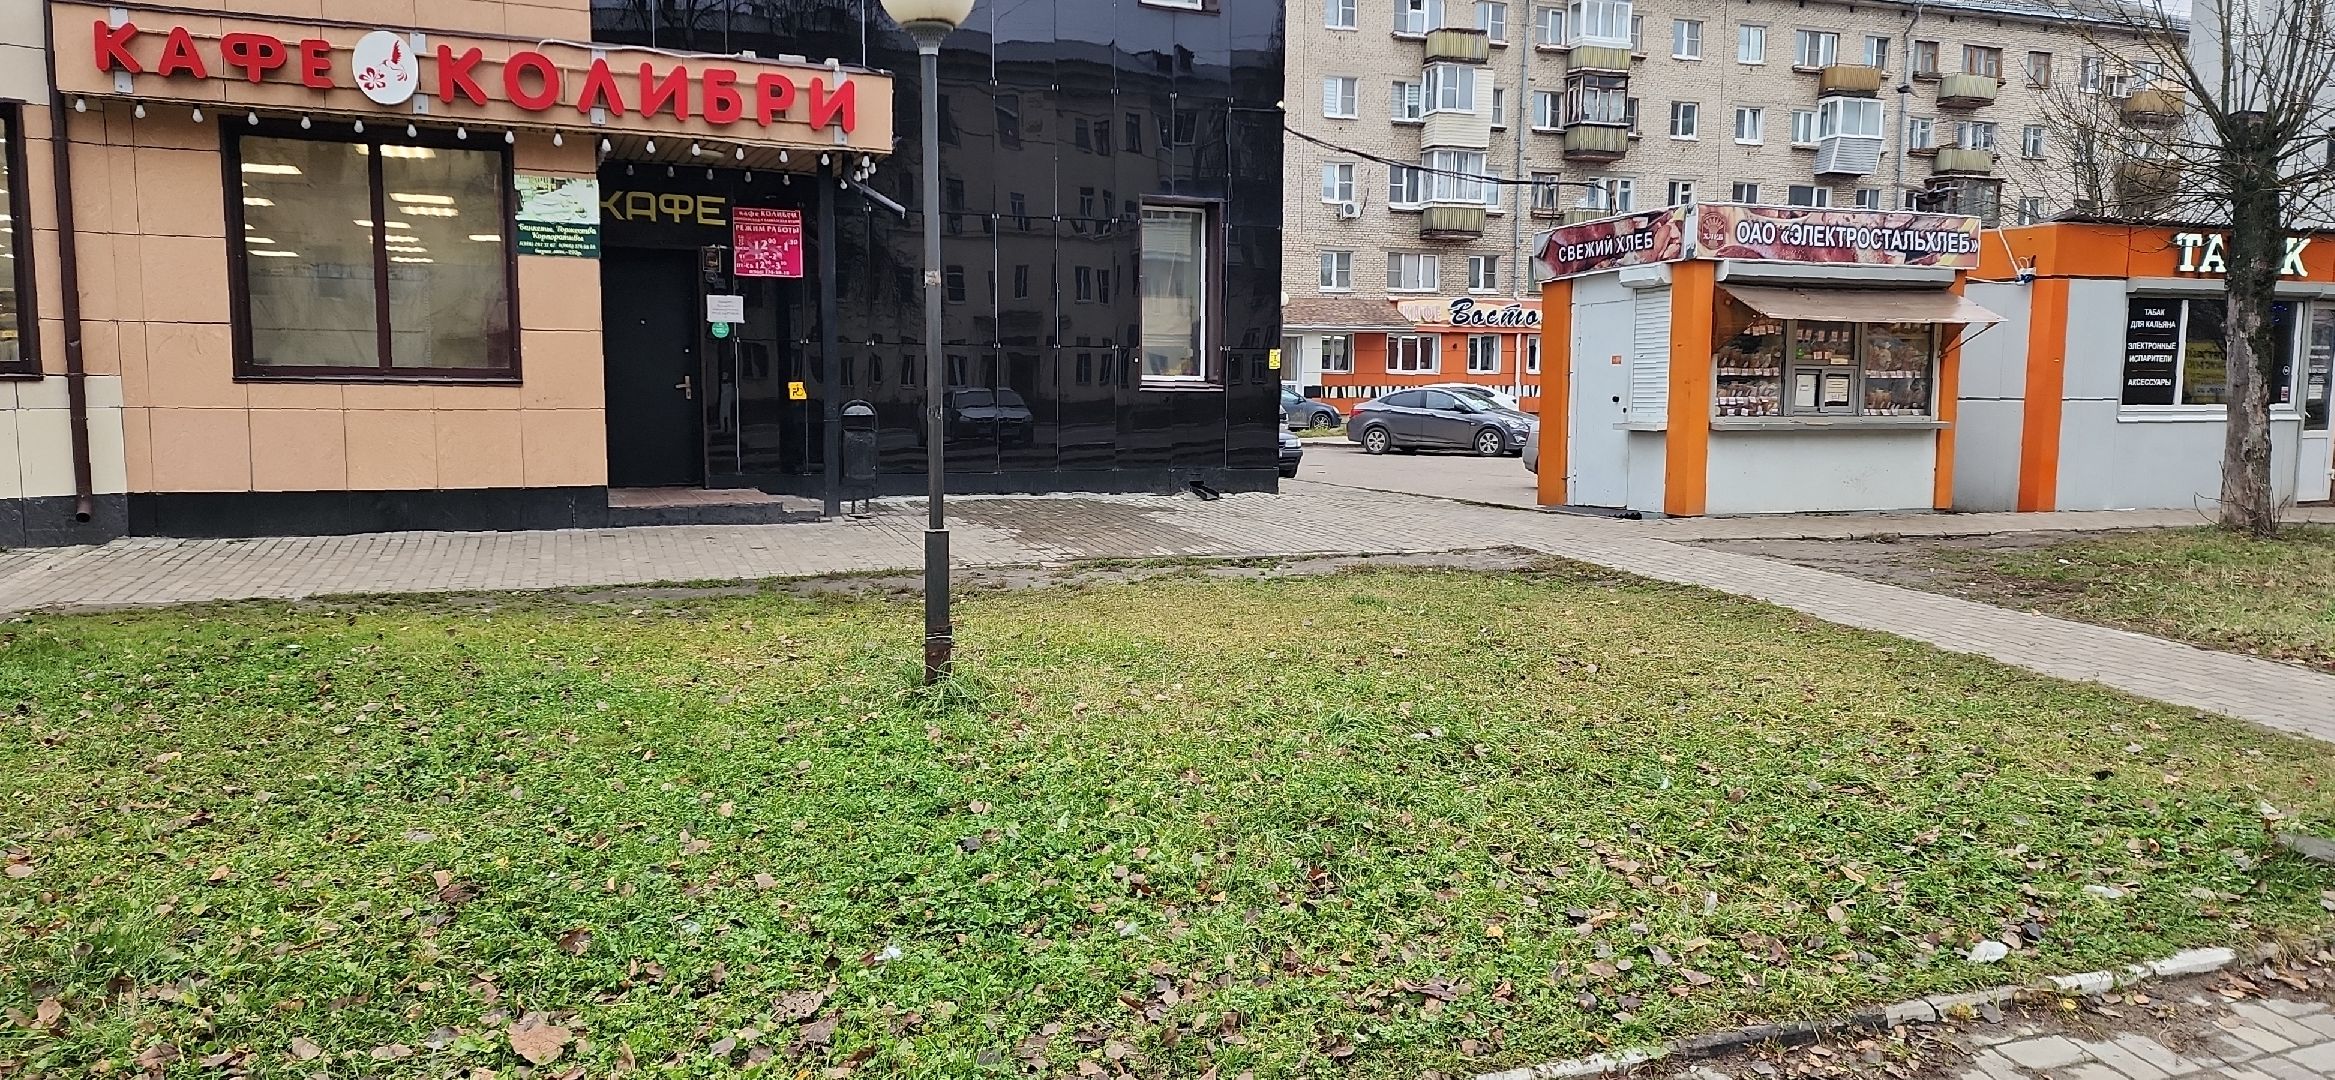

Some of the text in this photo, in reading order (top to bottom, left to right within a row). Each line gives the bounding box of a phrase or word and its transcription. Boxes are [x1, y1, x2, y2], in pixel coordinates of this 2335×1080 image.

[93, 20, 857, 134] КАФЕ КОЛИБРИ
[600, 190, 727, 226] КАФЕ
[760, 210, 798, 218] КОЛИБРИ
[735, 224, 800, 234] РЕЖИМ РАБОТЫ
[532, 231, 585, 242] Корпоративы
[1736, 221, 1979, 254] ОАО «ЭЛЕКТРОСТАЛЬХЛЕБ»
[1558, 231, 1654, 262] СВЕЖИЙ ХЛЕБ
[2176, 232, 2312, 277] ТАК
[1402, 297, 1542, 327] КАФЕ Восто
[2144, 308, 2166, 316] ТАБАК
[2130, 321, 2177, 329] ДЛЯ КАЛЬЯНА
[2127, 341, 2177, 350] ЭЛЕКТРОННЫЕ
[2128, 354, 2173, 363] ИСПАРИТЕЛИ
[2127, 378, 2172, 386] АКСЕССУАРЫ
